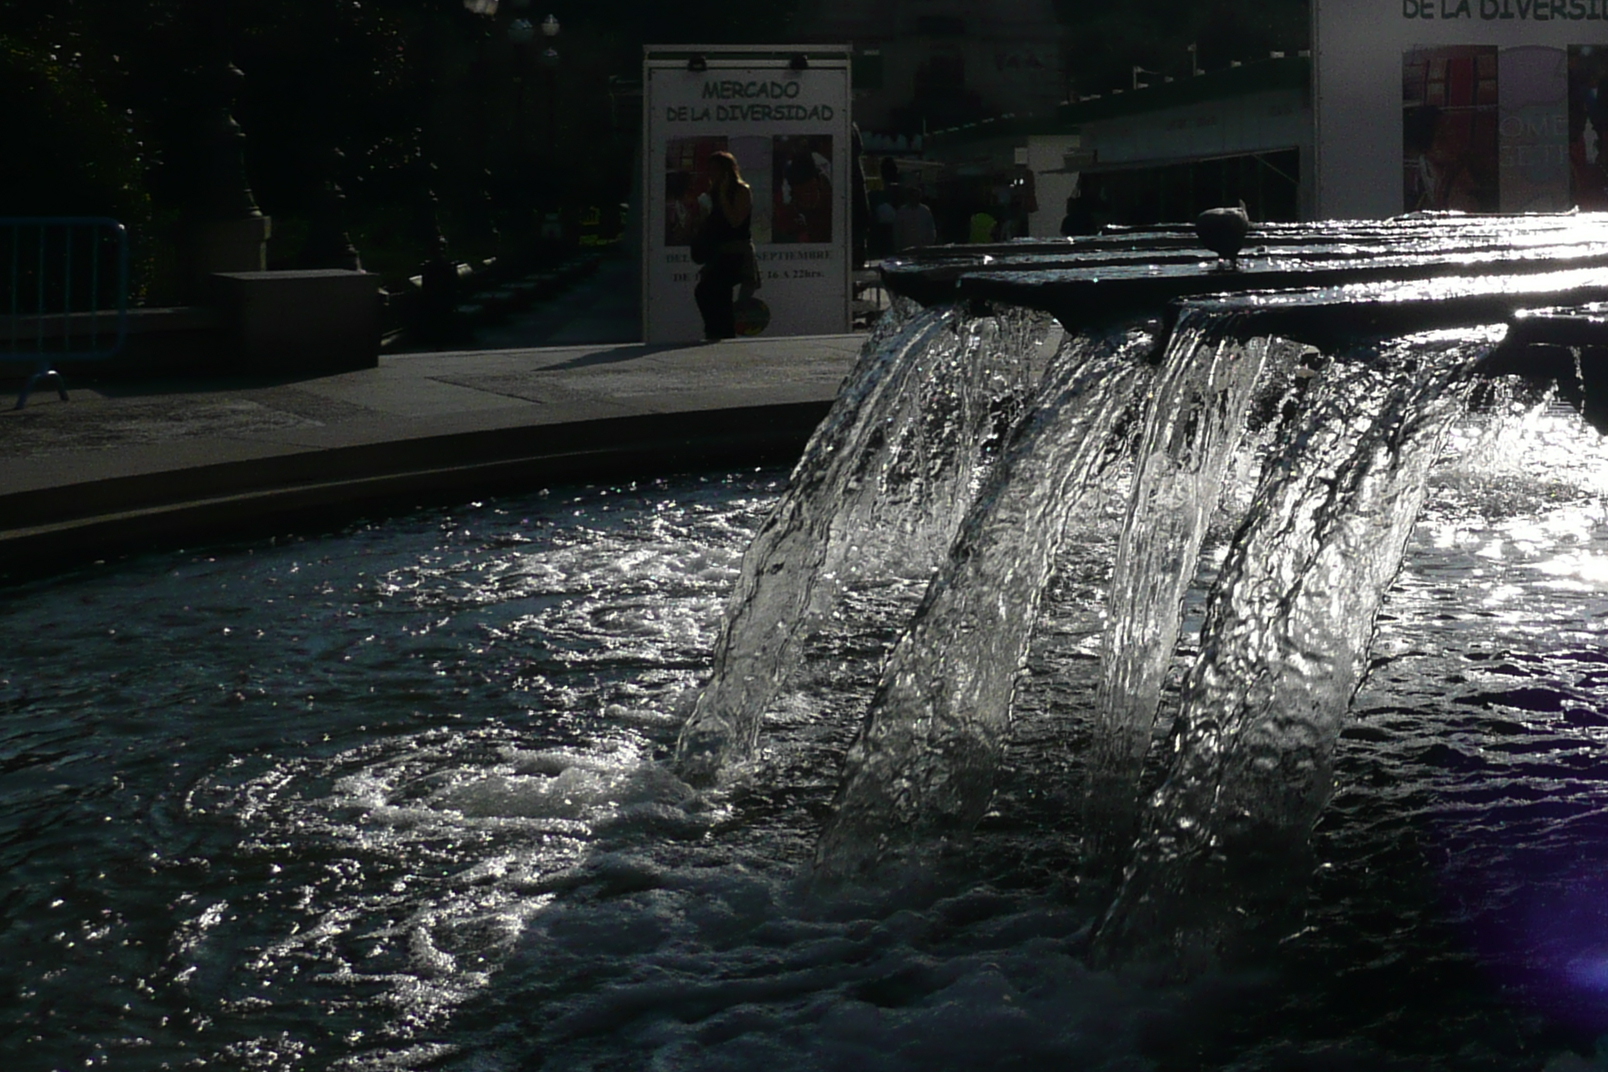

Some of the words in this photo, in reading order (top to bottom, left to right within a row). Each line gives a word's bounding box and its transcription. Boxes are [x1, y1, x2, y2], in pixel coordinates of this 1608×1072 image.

[701, 80, 800, 100] MERCADO
[666, 106, 688, 122] DE
[691, 106, 711, 122] LA
[716, 104, 834, 122] DIVERSIDAD
